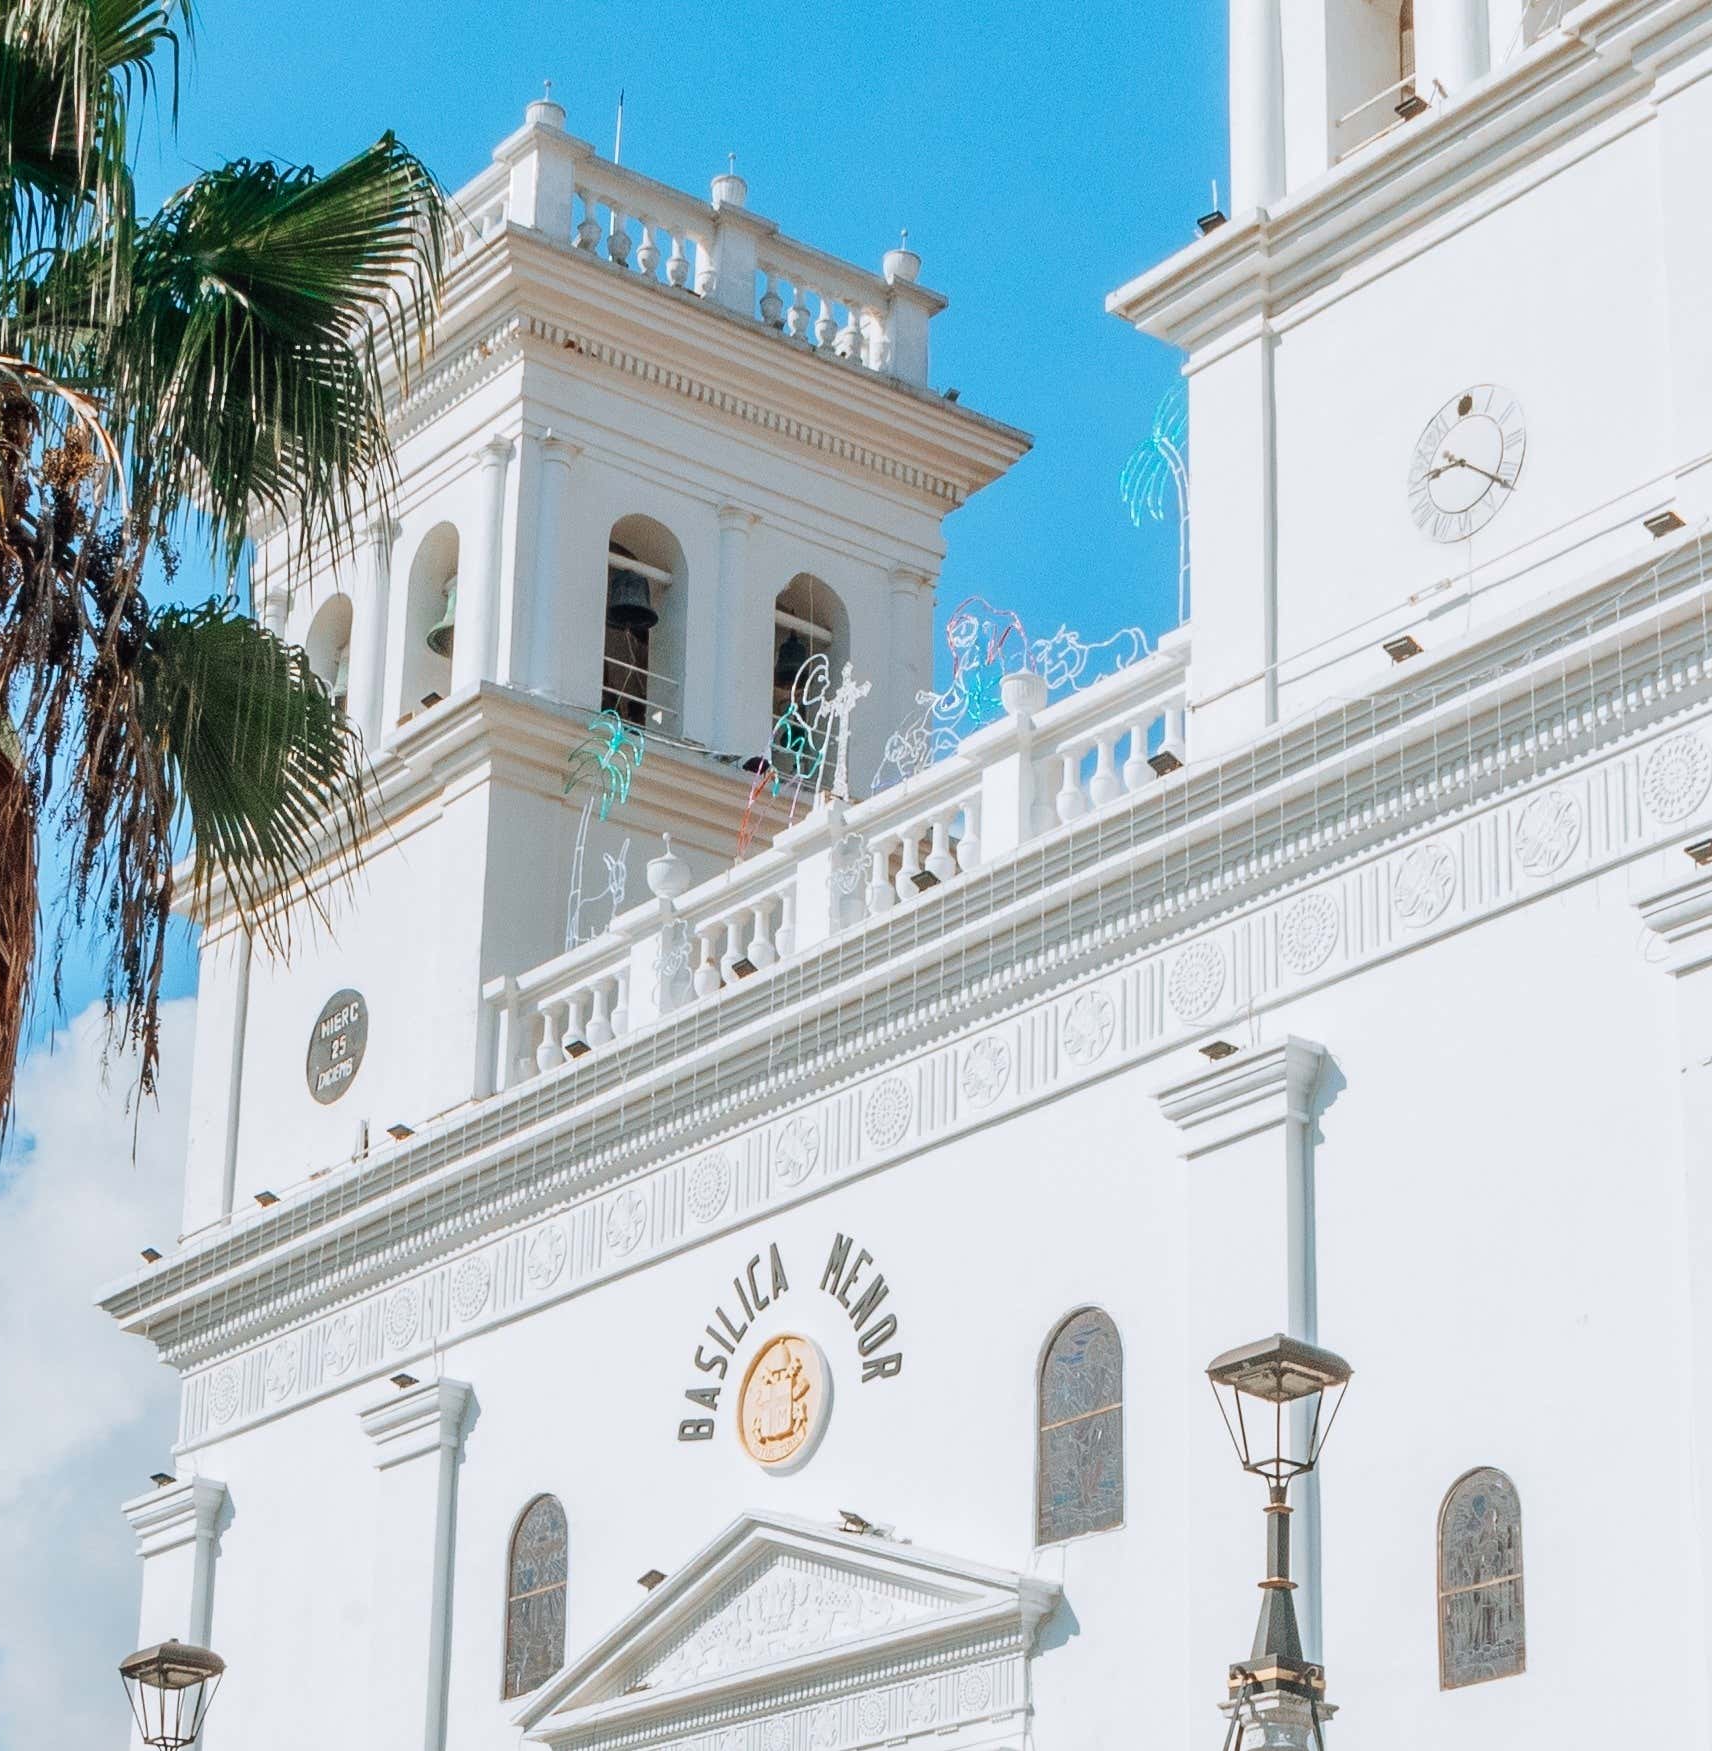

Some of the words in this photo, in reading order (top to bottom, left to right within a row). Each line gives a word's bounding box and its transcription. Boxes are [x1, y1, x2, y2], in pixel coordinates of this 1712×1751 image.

[320, 1001, 360, 1039] MIERC
[677, 1242, 789, 1441] BASILICA
[819, 1232, 903, 1383] MENOR
